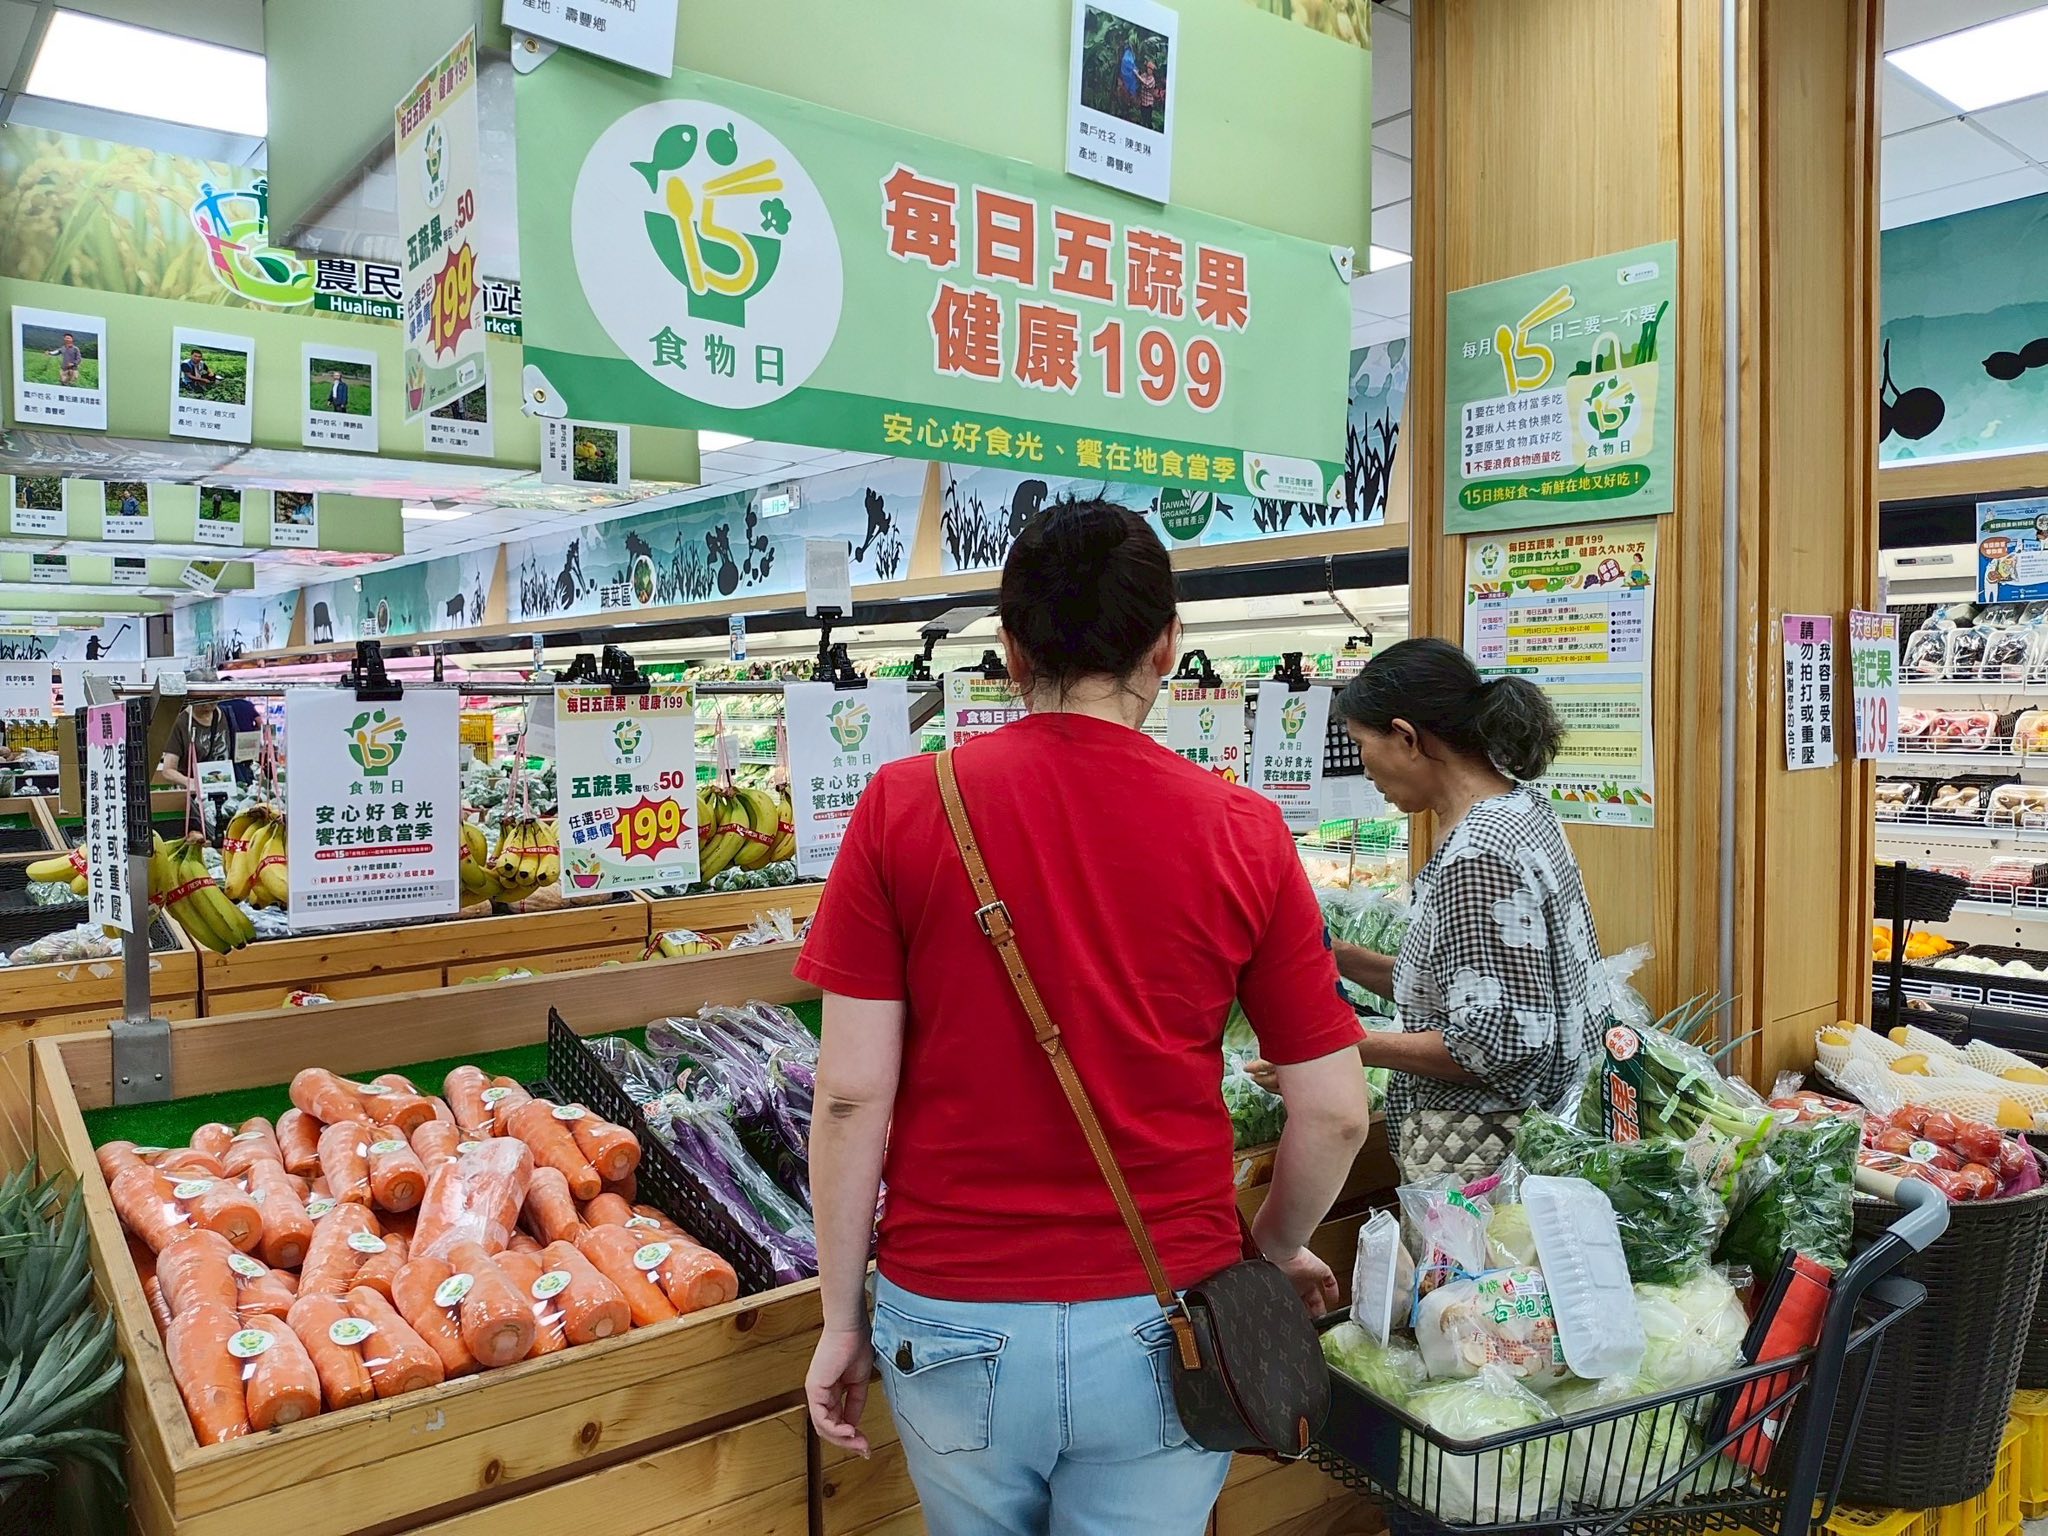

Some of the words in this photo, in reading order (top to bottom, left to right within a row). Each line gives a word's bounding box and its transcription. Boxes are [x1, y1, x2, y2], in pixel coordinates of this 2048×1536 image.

[406, 213, 443, 273] 五蔬果
[881, 163, 1251, 333] 每日五蔬果
[315, 259, 404, 300] 農民
[482, 282, 522, 316] 站
[431, 244, 473, 351] 199
[330, 295, 393, 318] Hualien
[1462, 337, 1492, 360] 每月
[1550, 303, 1658, 342] 日三要一不要
[650, 325, 786, 386] 食物日
[928, 282, 1227, 412] 健康199
[1475, 393, 1564, 419] 要在地食材當季吃
[883, 412, 1237, 486] 安心好食光、饗在地食當季
[1587, 440, 1631, 459] 食物日
[1474, 451, 1562, 473] 不要浪費食物適量吃
[1161, 499, 1190, 510] TAIWAN
[1161, 509, 1190, 519] ORGANIC
[1167, 515, 1205, 529] 有機農產品
[600, 582, 632, 609] 蔬菜區
[1800, 621, 1815, 765] 請勿拍打或重壓
[1819, 643, 1832, 744] 我容易受傷
[4, 707, 40, 718] 水果類
[1862, 696, 1888, 754] 139
[1279, 741, 1302, 751] 食物日
[615, 755, 642, 765] 食物日
[832, 754, 872, 768] 食物日
[1264, 755, 1313, 768] 安心好食光
[349, 780, 404, 796] 食物日
[571, 773, 633, 799] 五蔬果
[1263, 769, 1313, 783] 饗在地食當季
[316, 801, 434, 825] 安心好食光
[568, 807, 616, 830] 任選5包
[316, 822, 434, 847] 饗在地食當季
[572, 822, 613, 846] 優惠價
[615, 800, 681, 857] 199
[682, 839, 692, 850] 元
